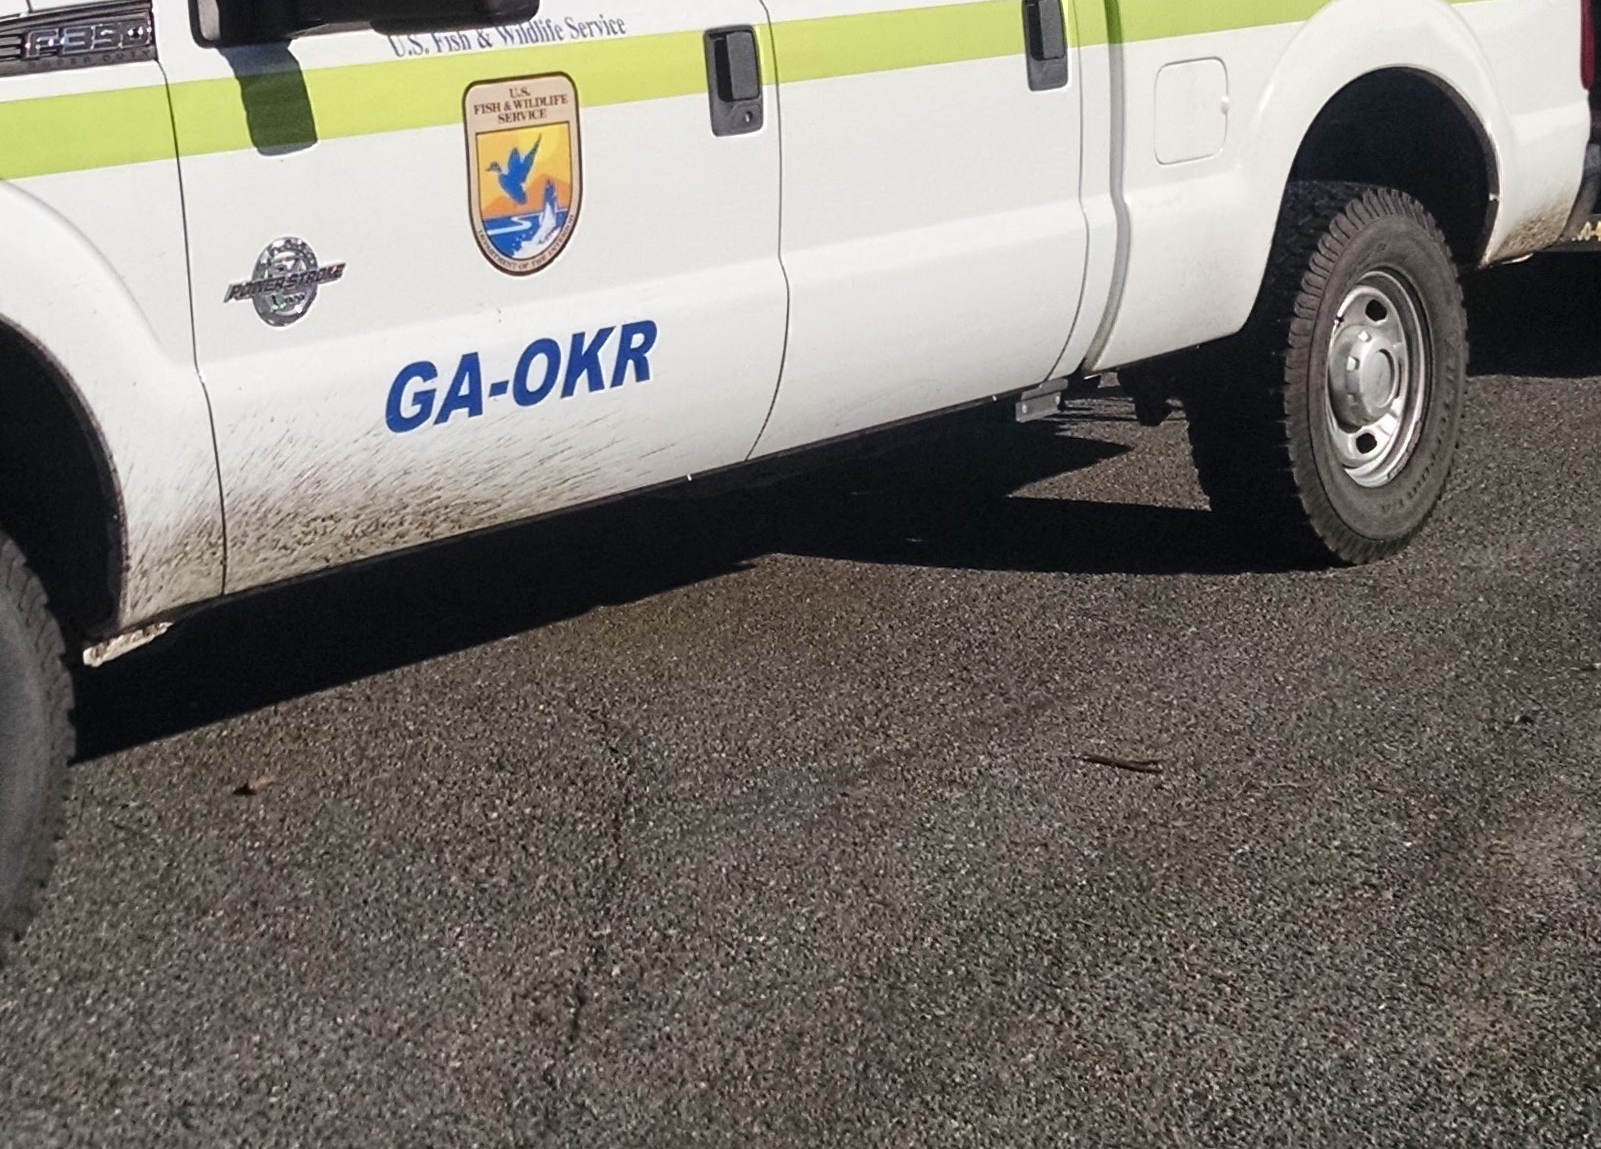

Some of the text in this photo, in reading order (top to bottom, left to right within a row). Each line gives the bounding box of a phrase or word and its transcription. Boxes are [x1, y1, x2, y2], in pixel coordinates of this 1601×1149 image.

[387, 14, 627, 57] U.S. Fish & Wildlife Service
[509, 86, 531, 99] U.S.
[473, 93, 569, 115] FISH & WILDLIFE
[497, 108, 547, 124] SERVICE
[385, 319, 658, 434] GA-OKR
